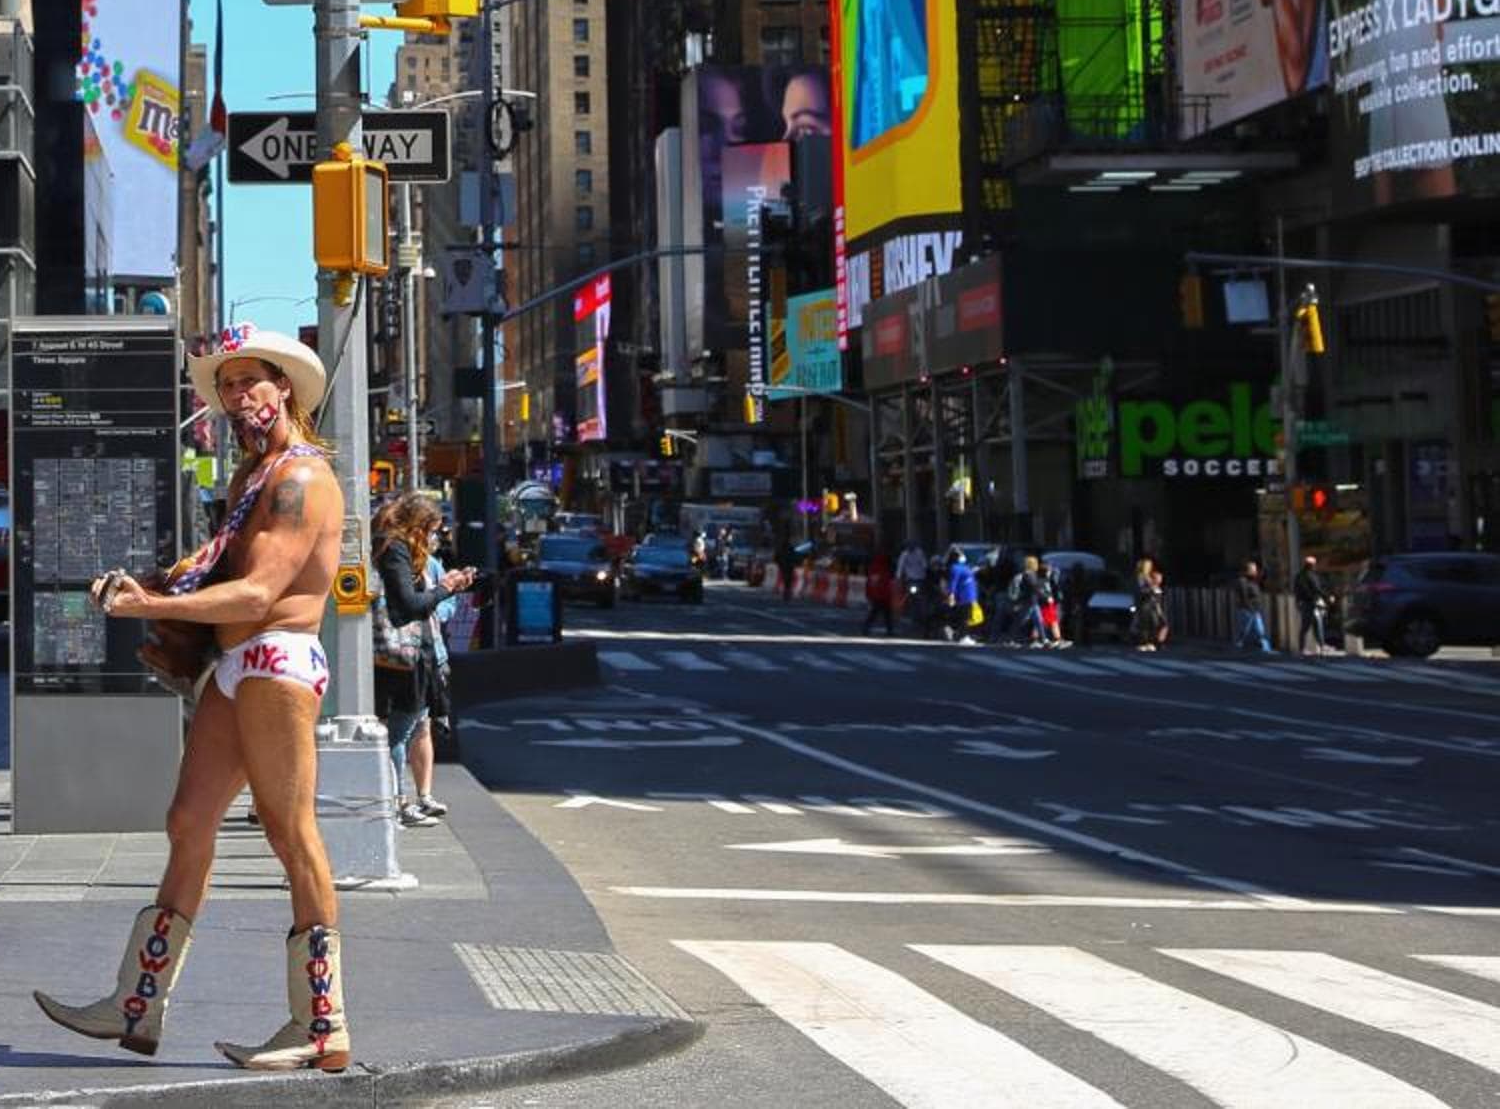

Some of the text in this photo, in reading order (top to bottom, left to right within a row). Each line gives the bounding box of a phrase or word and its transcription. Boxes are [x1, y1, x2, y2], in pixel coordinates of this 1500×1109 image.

[1328, 0, 1383, 58] EXPRESS
[1411, 42, 1441, 69] and
[1394, 69, 1479, 103] collection.
[262, 133, 418, 162] ONE WAY
[1383, 138, 1449, 171] COLLECTION
[1163, 459, 1282, 476] SOCCER
[243, 644, 289, 675] NYC
